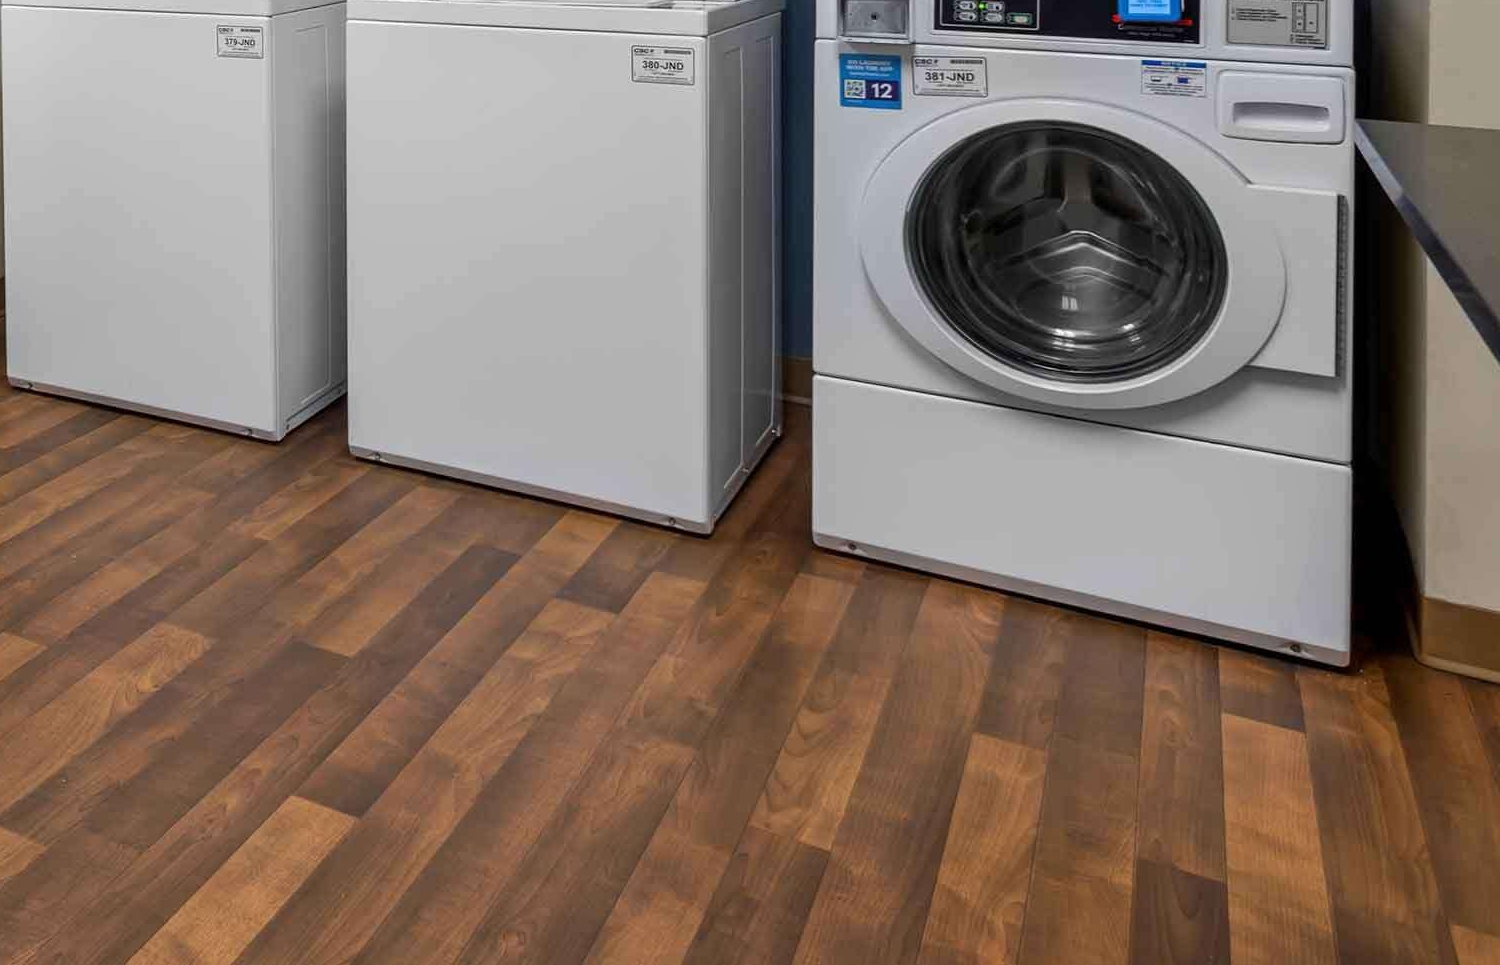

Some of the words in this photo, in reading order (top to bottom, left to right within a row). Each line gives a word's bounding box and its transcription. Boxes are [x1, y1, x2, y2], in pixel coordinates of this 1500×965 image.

[642, 60, 684, 71] 380-JND
[925, 72, 975, 82] 381-JND
[871, 83, 893, 99] 12
